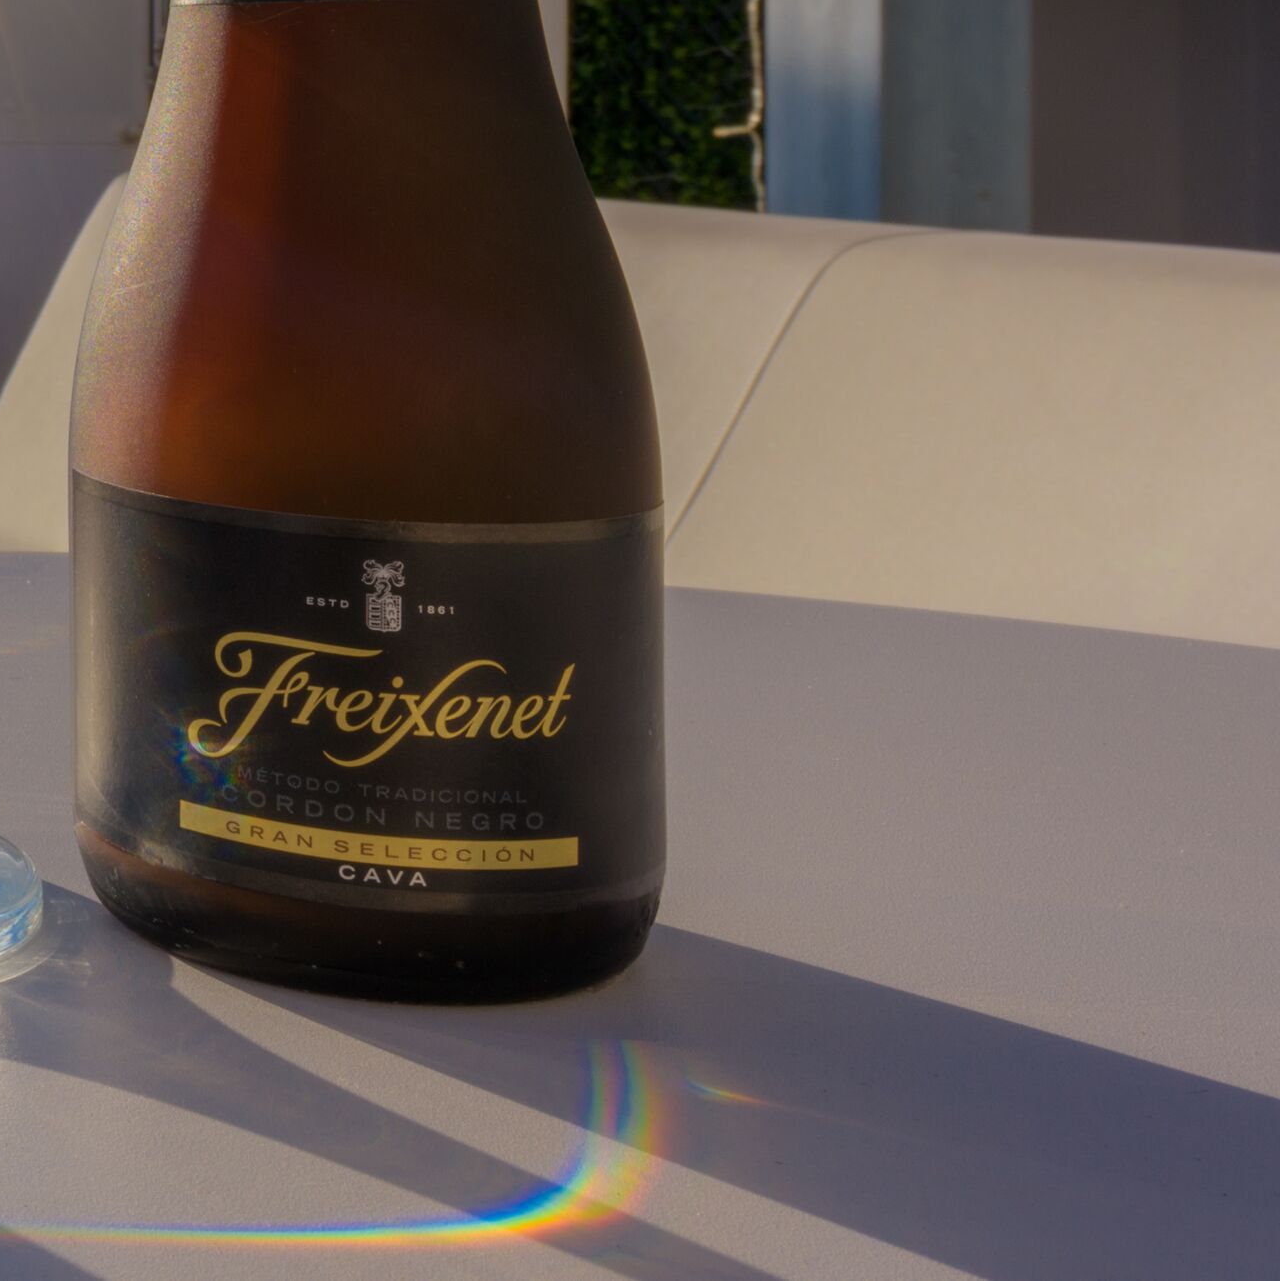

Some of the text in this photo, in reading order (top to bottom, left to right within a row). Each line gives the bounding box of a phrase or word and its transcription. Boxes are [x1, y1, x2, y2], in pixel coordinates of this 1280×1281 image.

[305, 595, 455, 615] ESTD 1861
[187, 630, 576, 768] Freixenet
[238, 767, 528, 804] MÉTODO TRADICIONAL
[415, 810, 544, 831] NEGRO
[225, 820, 536, 863] GRAN SELECCIÓN
[339, 864, 427, 888] CAVA
